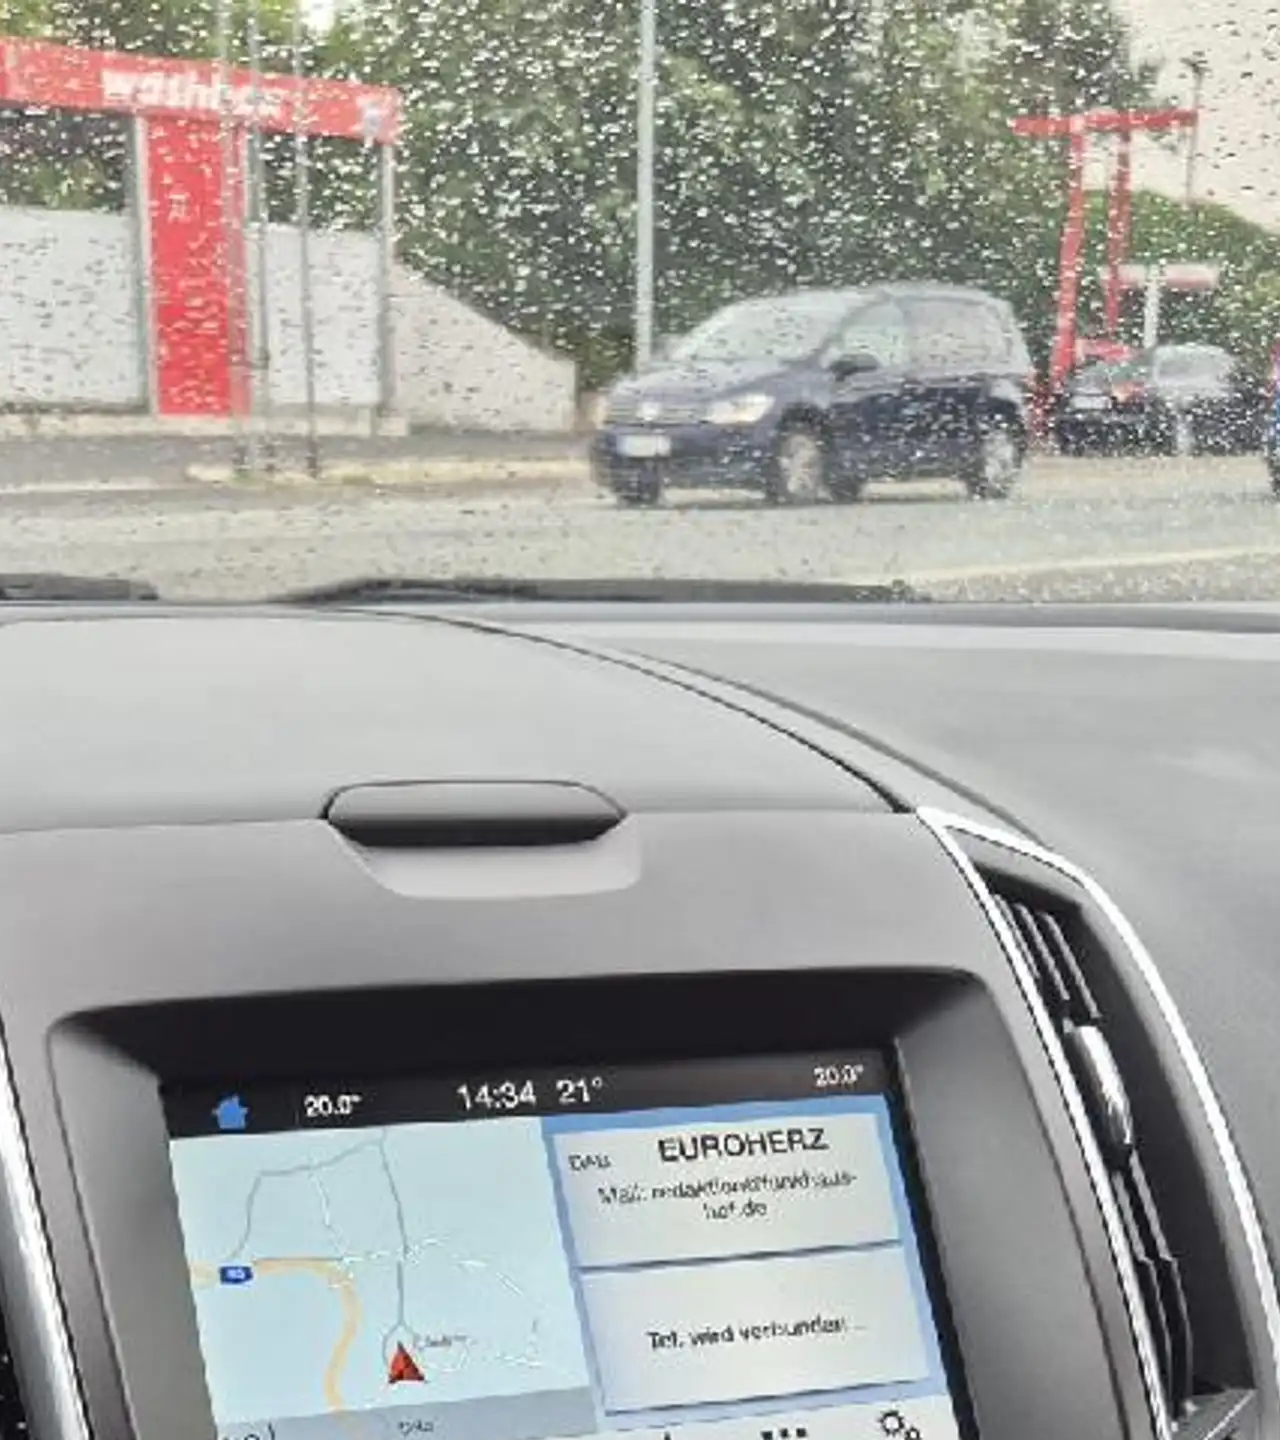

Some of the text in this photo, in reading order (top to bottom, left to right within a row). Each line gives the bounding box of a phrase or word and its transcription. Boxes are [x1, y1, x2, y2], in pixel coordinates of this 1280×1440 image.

[457, 1080, 537, 1112] 14:34
[556, 1076, 604, 1104] 21°
[659, 1128, 830, 1162] EUROHERZ
